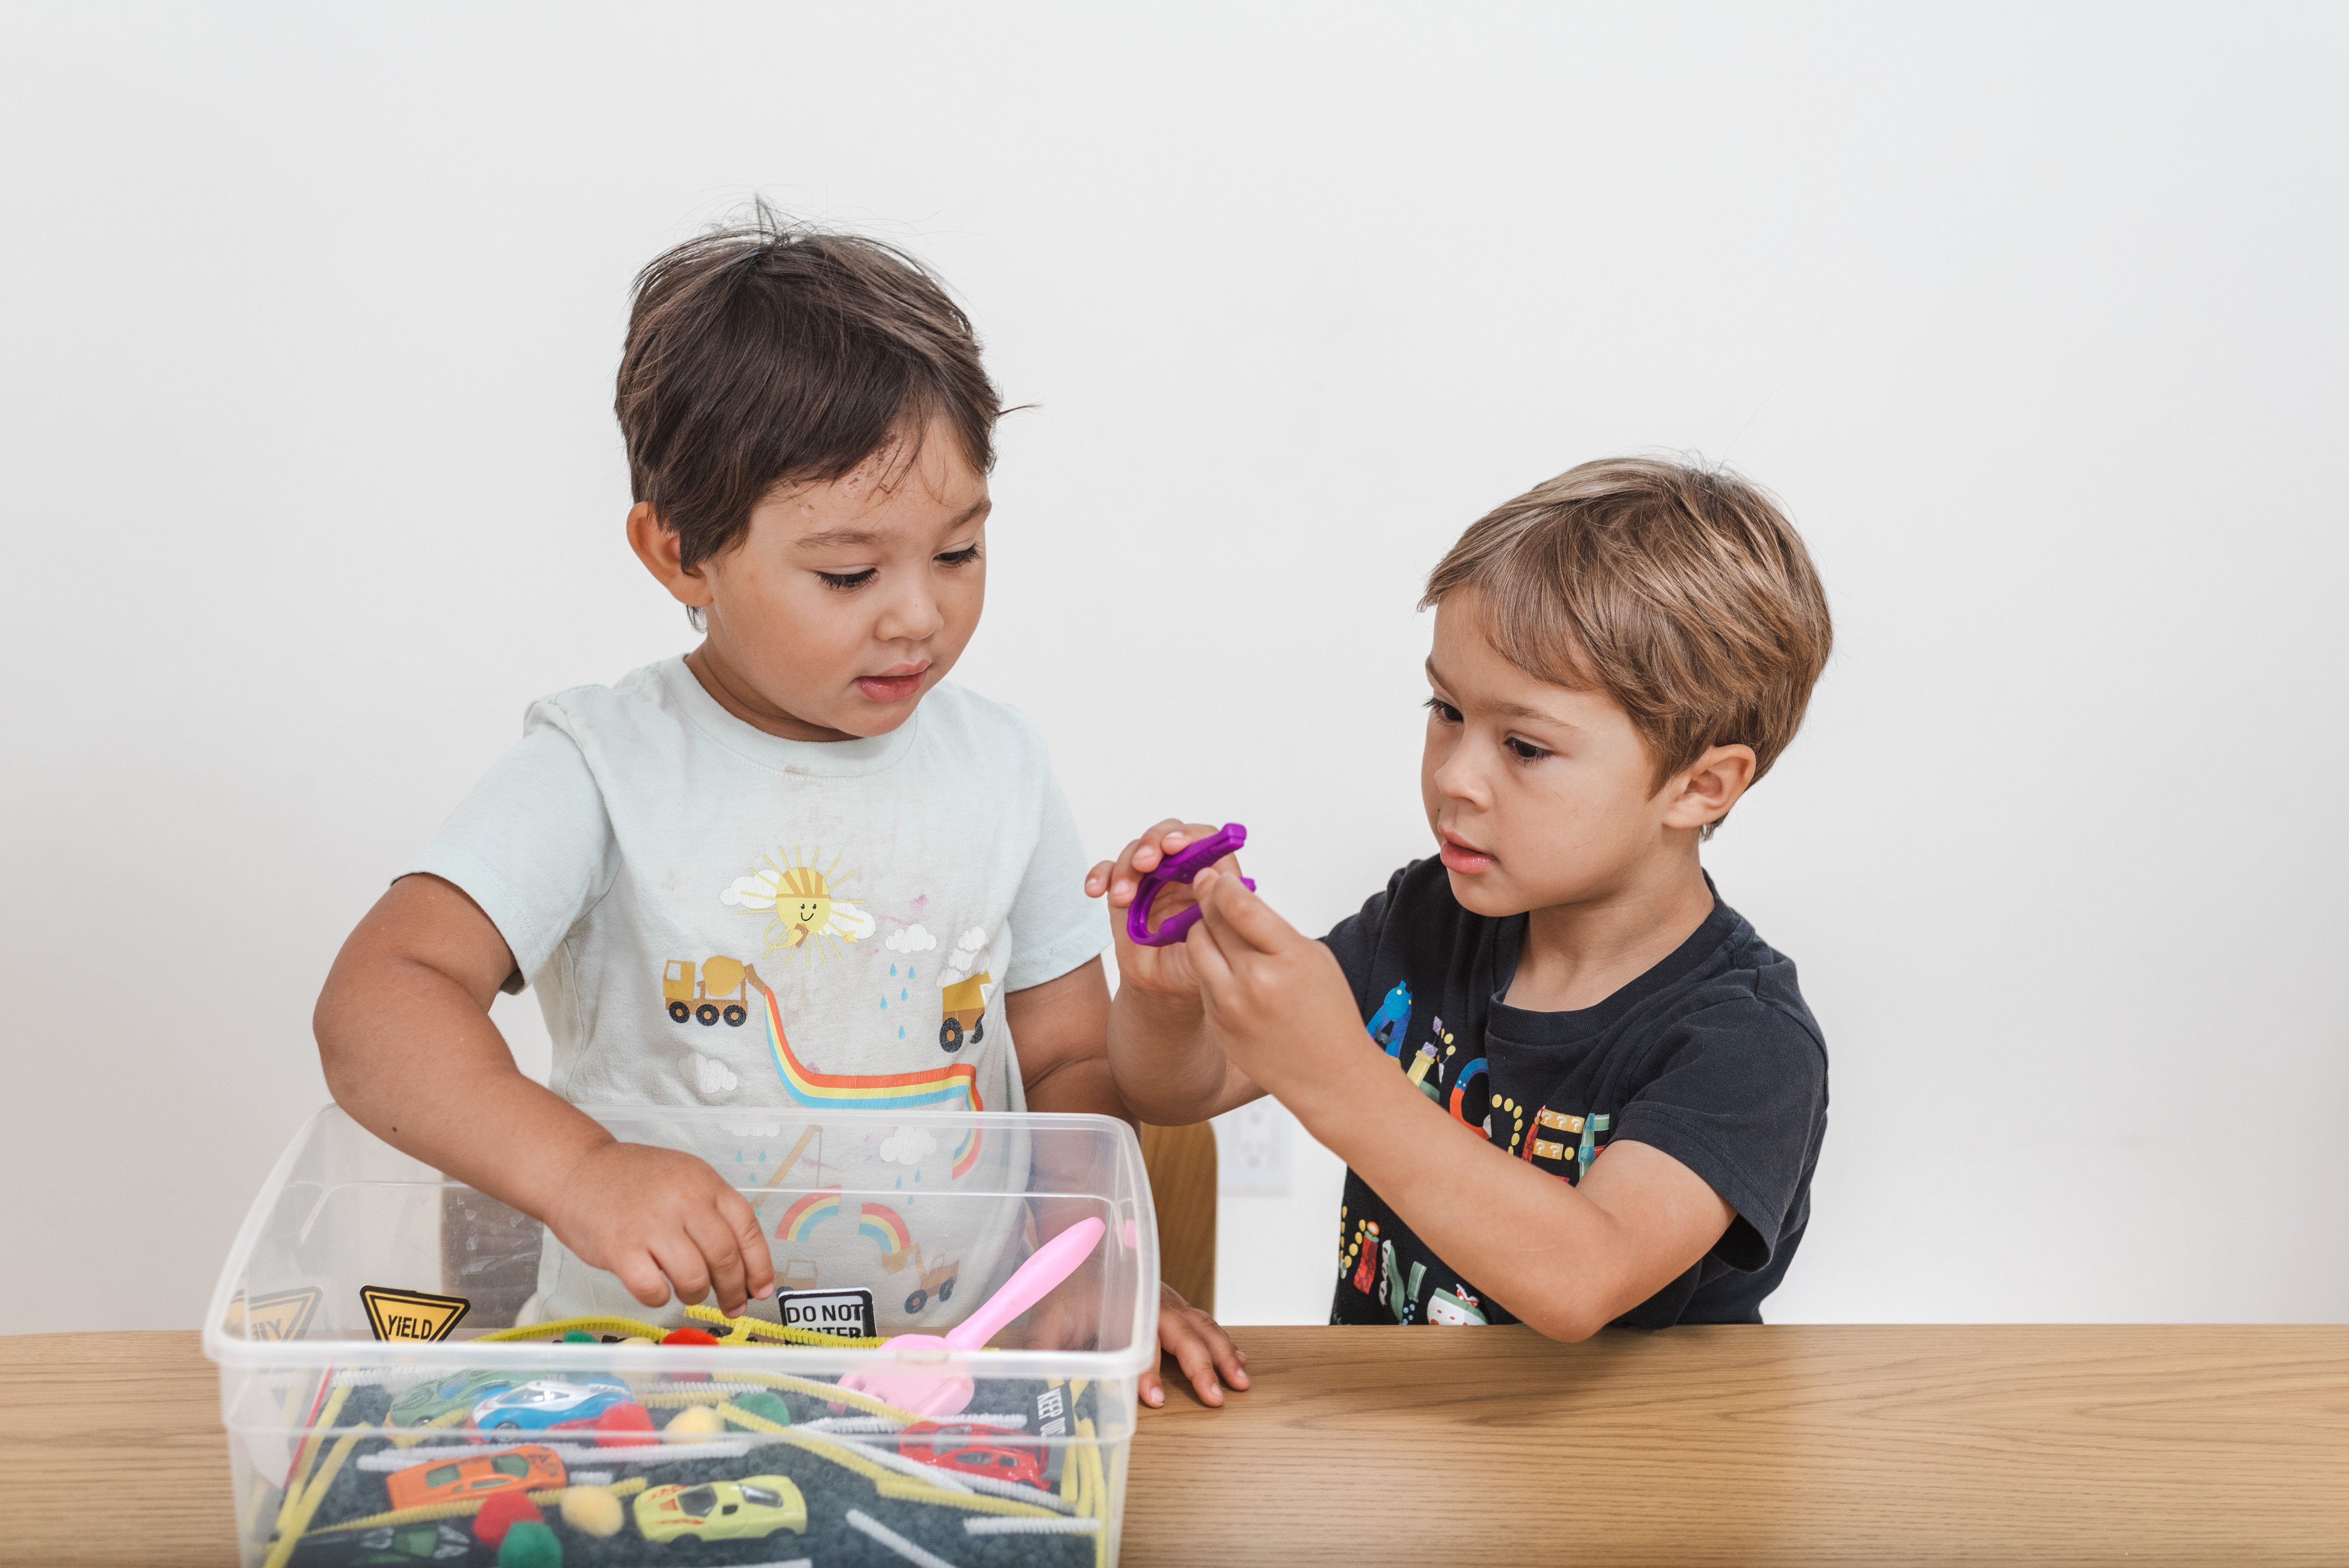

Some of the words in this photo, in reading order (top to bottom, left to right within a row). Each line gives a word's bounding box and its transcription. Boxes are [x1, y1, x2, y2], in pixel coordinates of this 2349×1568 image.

[786, 1305, 816, 1323] DO
[821, 1304, 863, 1322] NOT
[388, 1315, 432, 1340] YIELD
[1037, 1387, 1064, 1420] KEEP
